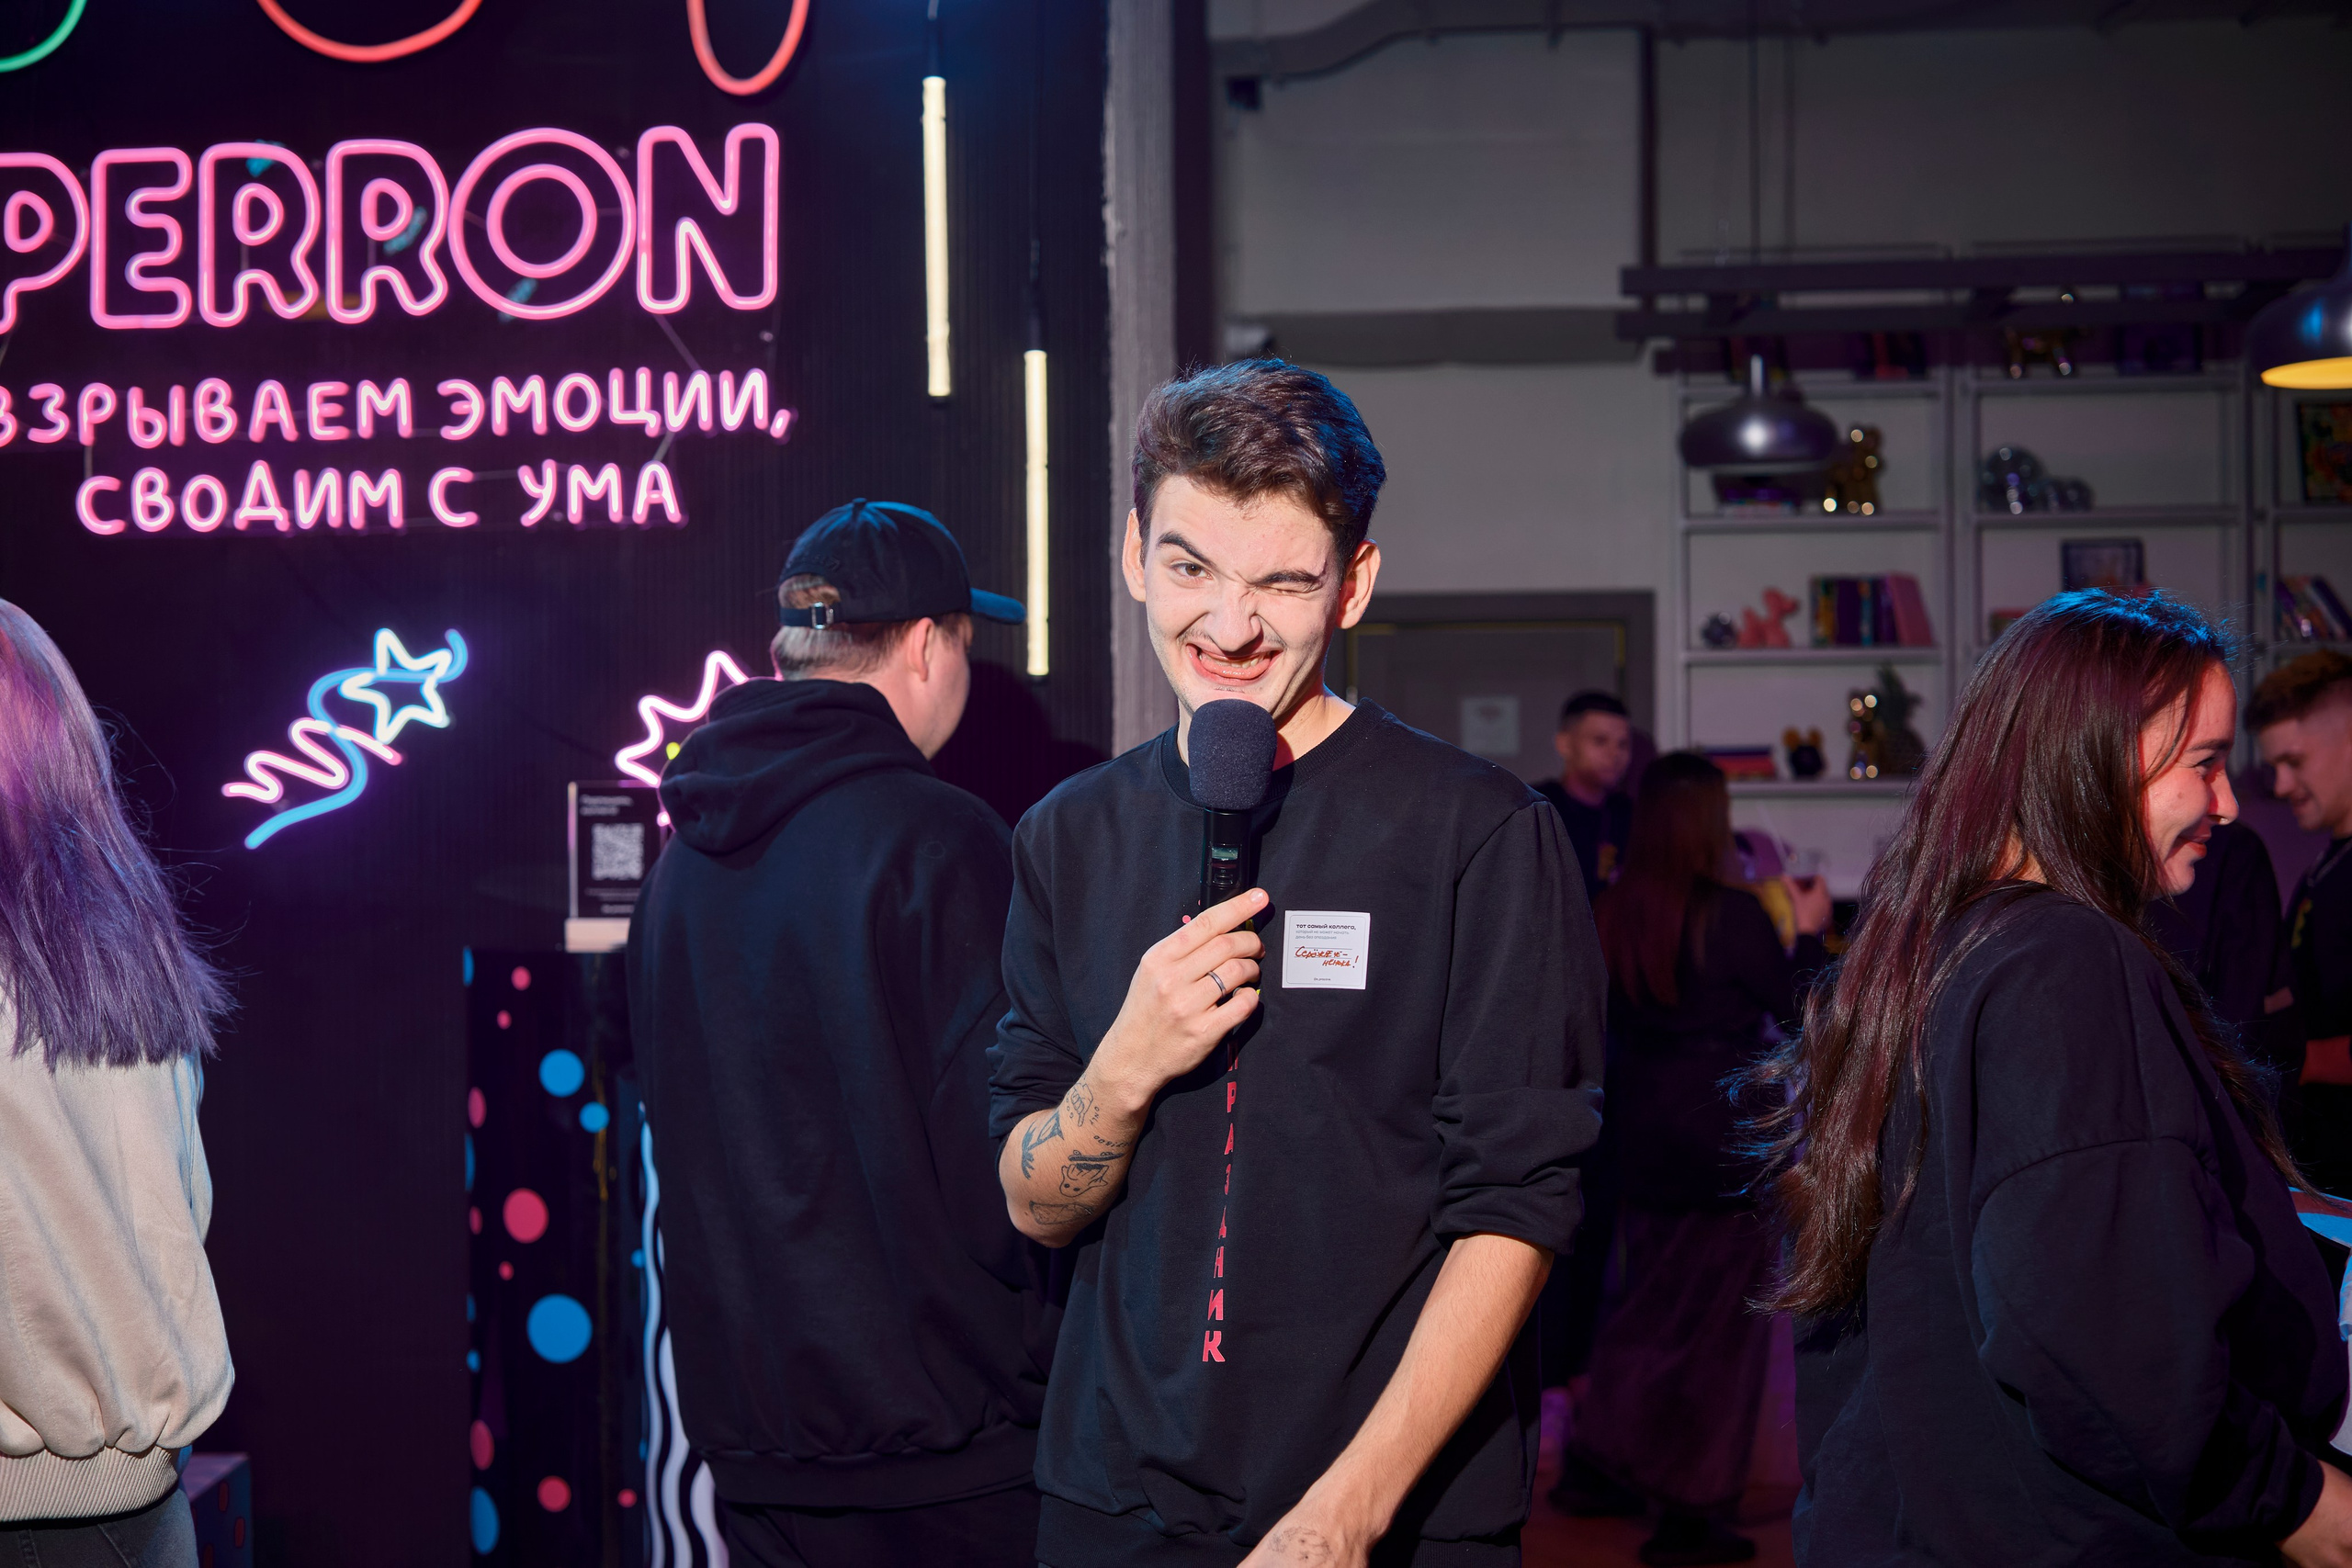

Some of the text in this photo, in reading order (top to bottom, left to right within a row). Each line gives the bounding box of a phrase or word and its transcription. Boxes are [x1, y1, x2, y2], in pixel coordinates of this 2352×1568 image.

[437, 367, 795, 441] ЭМОЦИИ,
[77, 460, 684, 534] СВОДИМ С УМА
